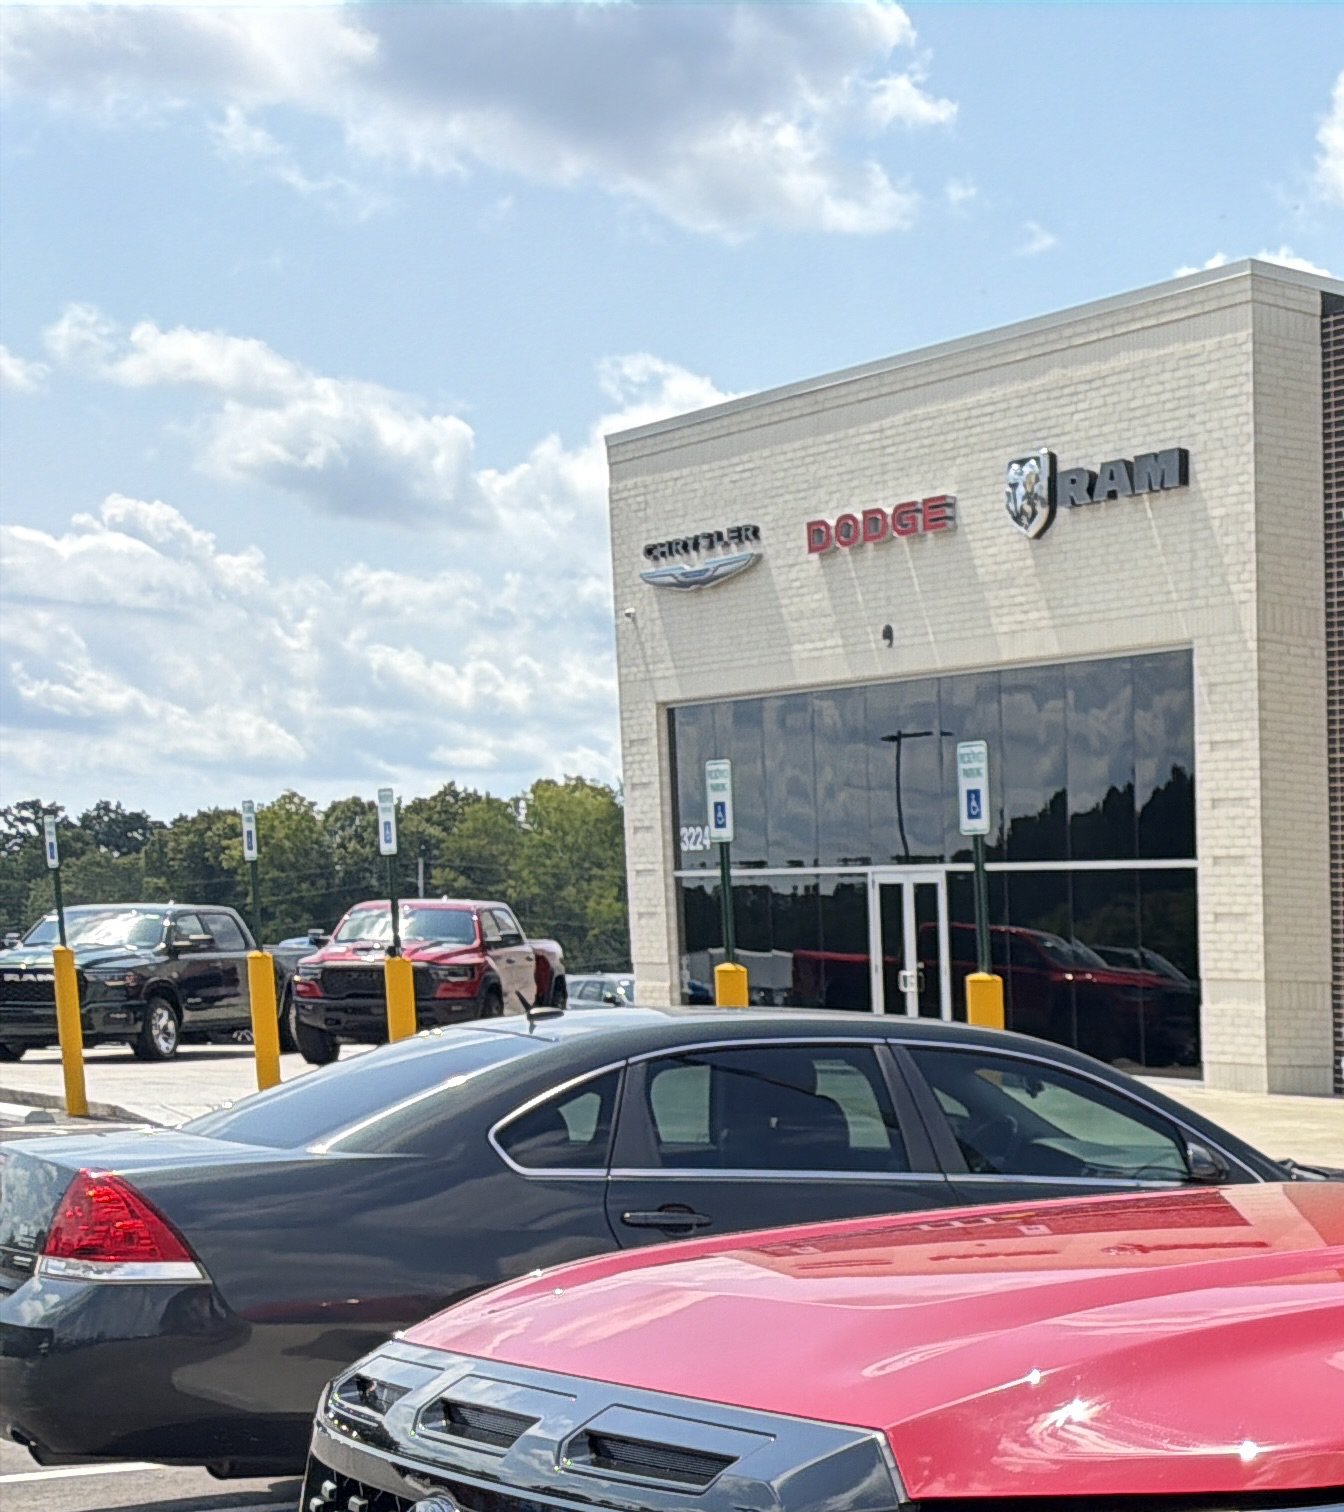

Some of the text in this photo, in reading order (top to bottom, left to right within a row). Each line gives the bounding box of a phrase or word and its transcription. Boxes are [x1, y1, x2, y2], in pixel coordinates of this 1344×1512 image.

[1056, 447, 1189, 508] RAM
[643, 524, 760, 561] CHRYSLER
[807, 495, 957, 554] DODGE
[680, 825, 711, 851] 3224
